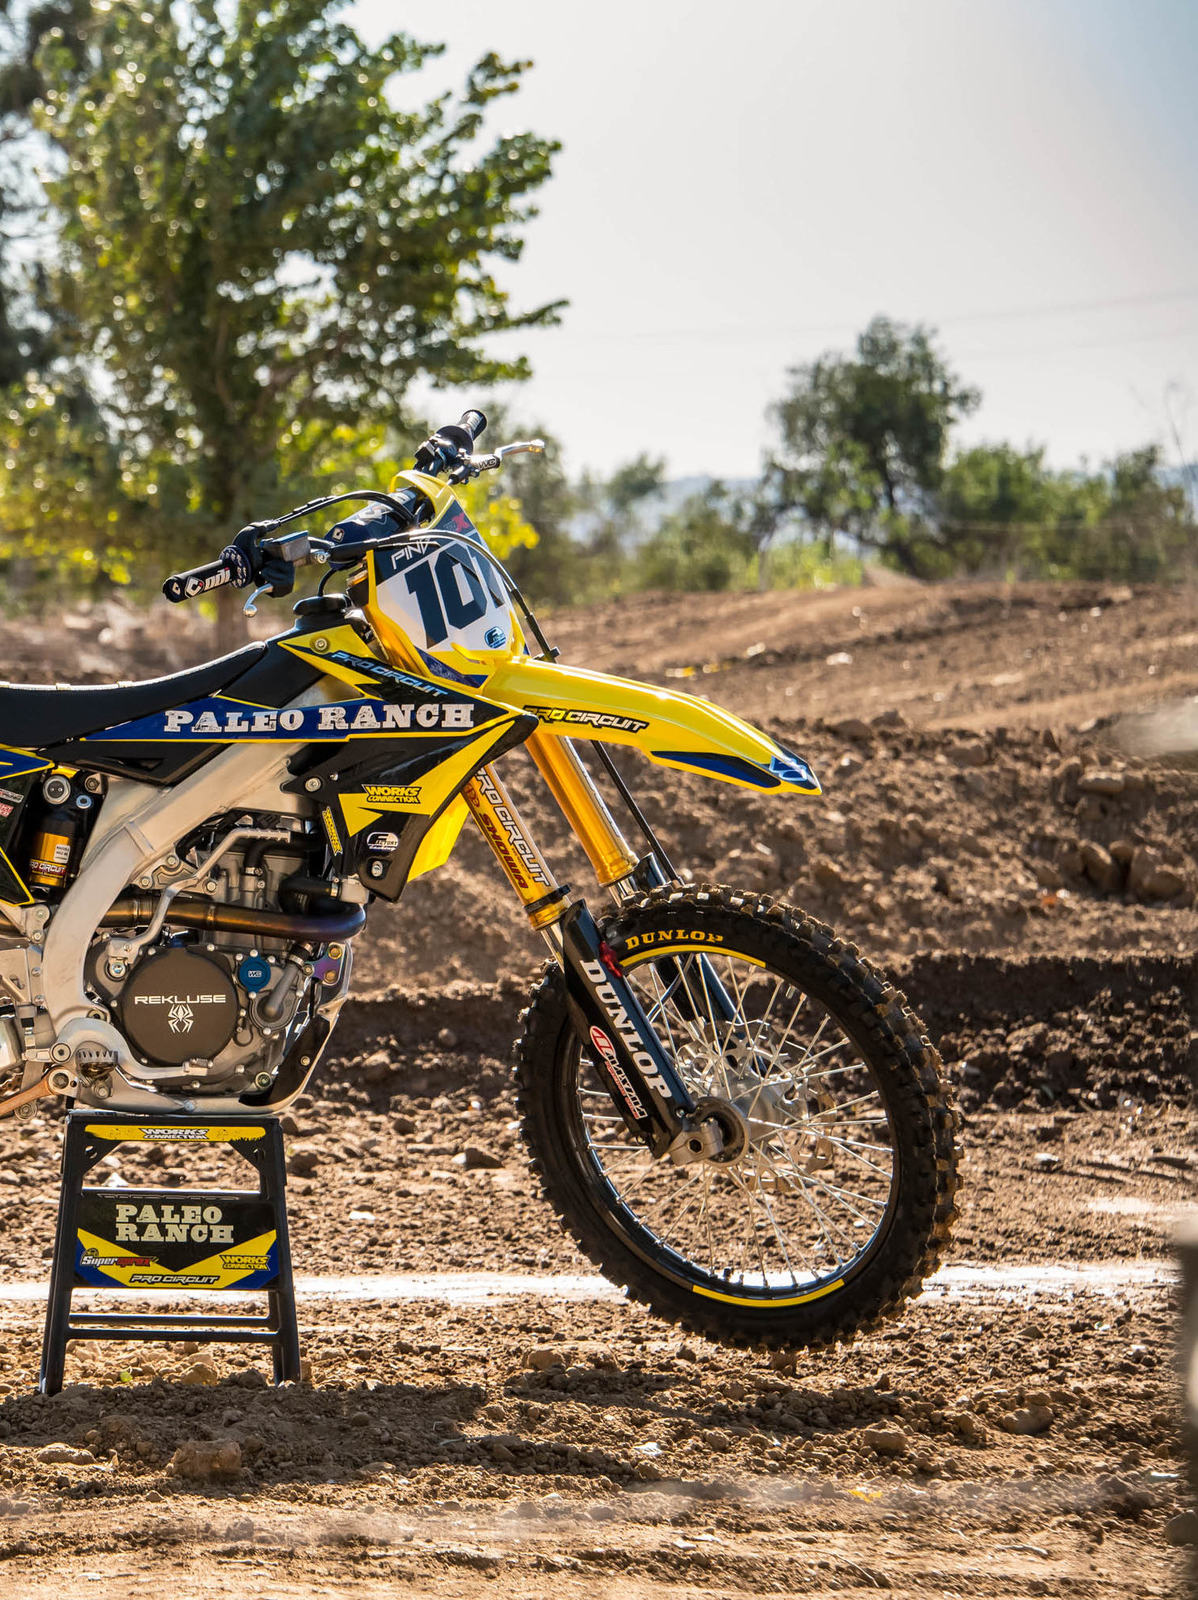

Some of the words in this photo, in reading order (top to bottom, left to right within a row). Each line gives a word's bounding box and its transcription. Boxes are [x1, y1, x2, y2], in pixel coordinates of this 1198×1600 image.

[404, 542, 506, 650] 101
[332, 651, 375, 670] PRO
[371, 665, 449, 698] CIRCUIT
[163, 709, 305, 733] PALEO
[317, 703, 475, 732] RANCH
[566, 710, 647, 731] CIRCUIT
[365, 786, 421, 797] WORKS
[367, 795, 419, 804] CONNECTION
[479, 813, 529, 889] SHOWA
[493, 806, 551, 887] CIRCUIT
[625, 929, 724, 951] DUNLOP
[134, 994, 227, 1005] REKLUSE
[578, 958, 673, 1098] DUNLOP
[115, 1204, 223, 1224] PALEO
[115, 1223, 234, 1244] RANCH
[221, 1255, 269, 1264] WORKS
[131, 1275, 161, 1283] PRO
[162, 1275, 219, 1284] CIRCUIT
